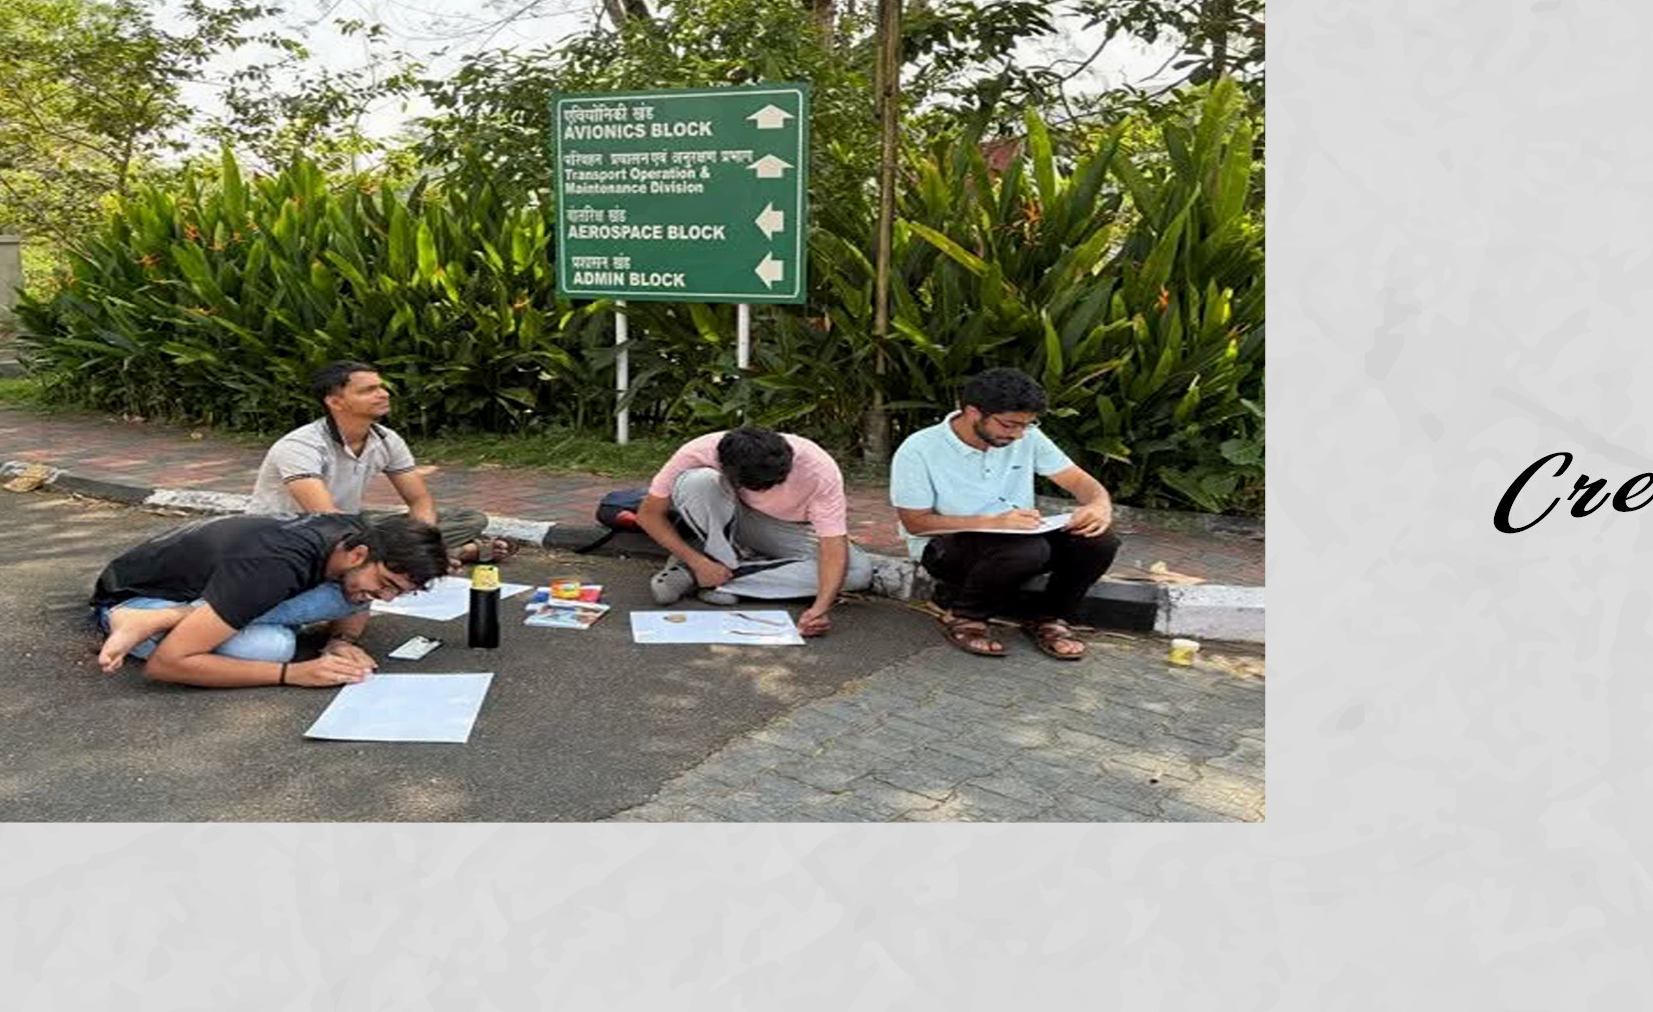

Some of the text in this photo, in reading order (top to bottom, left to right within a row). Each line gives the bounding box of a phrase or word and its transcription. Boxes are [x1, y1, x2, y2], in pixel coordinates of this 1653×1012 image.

[564, 121, 713, 140] AVIONICS BLOCK
[564, 166, 710, 182] Transport Operation &
[564, 181, 704, 194] Maintenance Division
[567, 224, 726, 240] AEROSPACE BLOCK
[573, 271, 686, 287] ADMIN BLOCK
